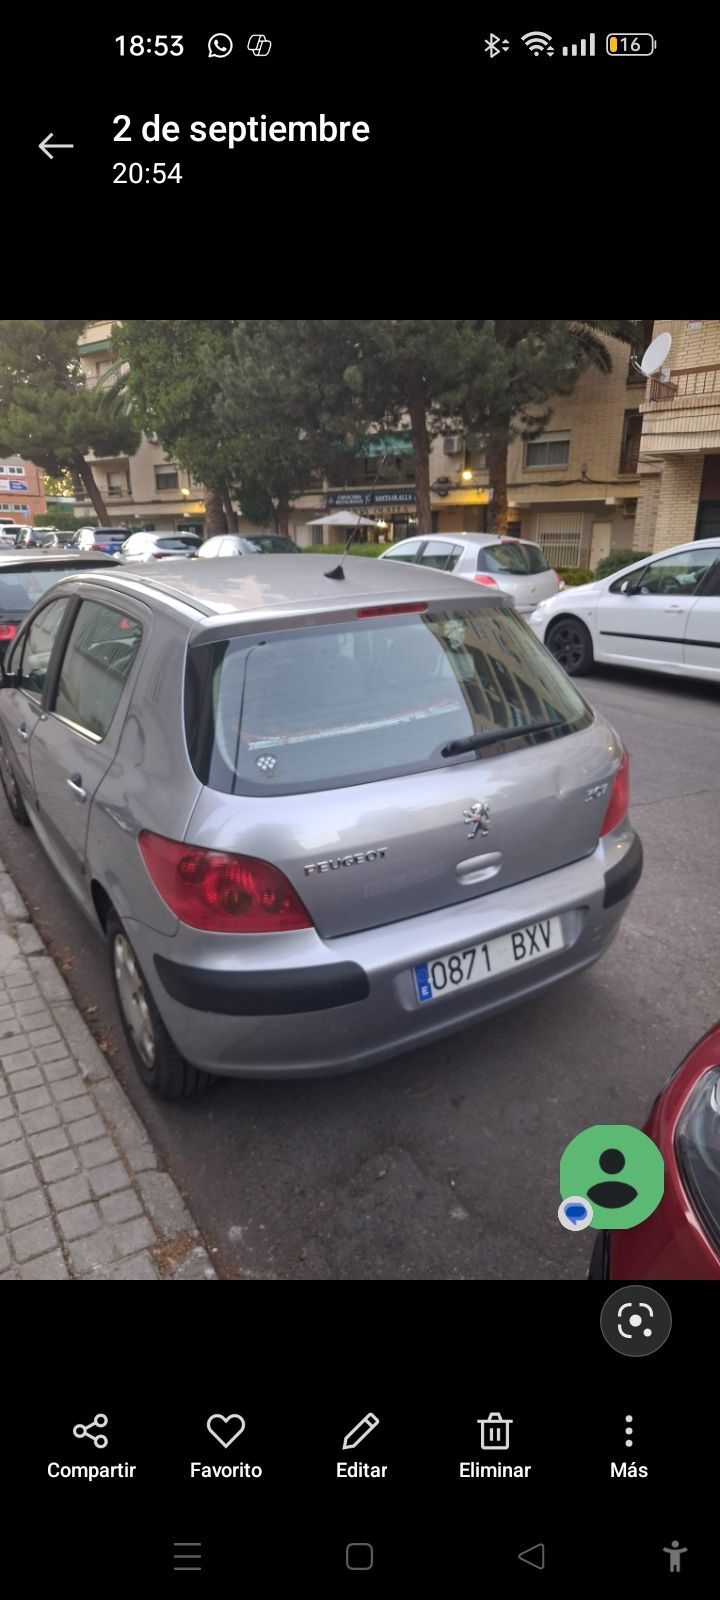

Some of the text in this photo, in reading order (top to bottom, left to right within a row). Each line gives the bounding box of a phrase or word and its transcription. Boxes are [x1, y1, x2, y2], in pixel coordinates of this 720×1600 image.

[375, 493, 412, 502] SANTA OLALLA
[304, 847, 388, 877] PEUGEOT
[431, 920, 551, 990] 0871 BXV
[421, 986, 429, 996] E
